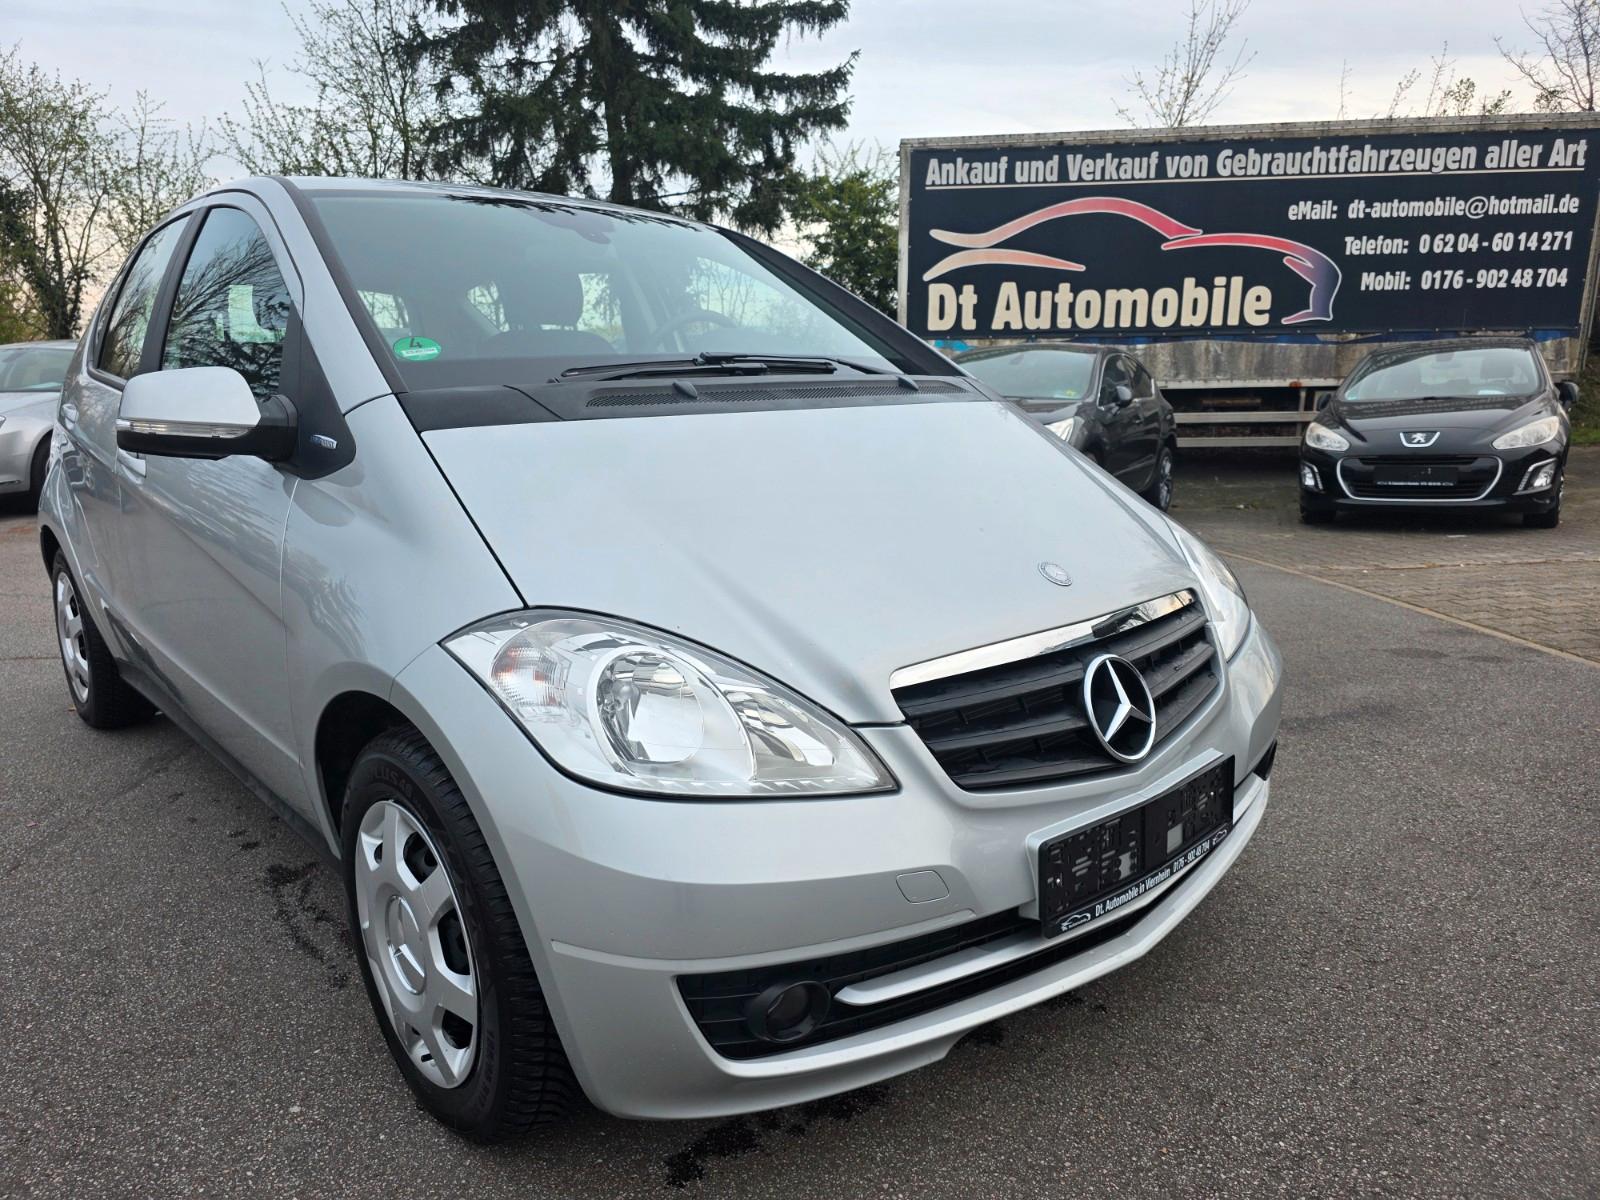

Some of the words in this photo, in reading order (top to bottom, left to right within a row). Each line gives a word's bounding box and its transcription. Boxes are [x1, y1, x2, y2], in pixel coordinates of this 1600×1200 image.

[925, 155, 1009, 186] Ankauf
[1014, 154, 1060, 183] und
[1066, 151, 1159, 182] Verkauf
[1165, 153, 1209, 178] von
[1216, 144, 1477, 178] Gebrauchtfahrzeugen
[1484, 139, 1543, 169] aller
[1547, 138, 1588, 168] Art
[1287, 200, 1338, 221] eMail:
[1347, 193, 1580, 220] dt-automobile@hotmail.de
[1344, 235, 1409, 256] Telefon:
[1360, 271, 1411, 292] Mobil:
[1420, 269, 1464, 290] 0176
[927, 282, 978, 332] Dt
[990, 275, 1272, 331] Automobile
[1106, 886, 1139, 912] Automobile
[1139, 882, 1145, 894] in
[1145, 867, 1170, 890] Viernheim
